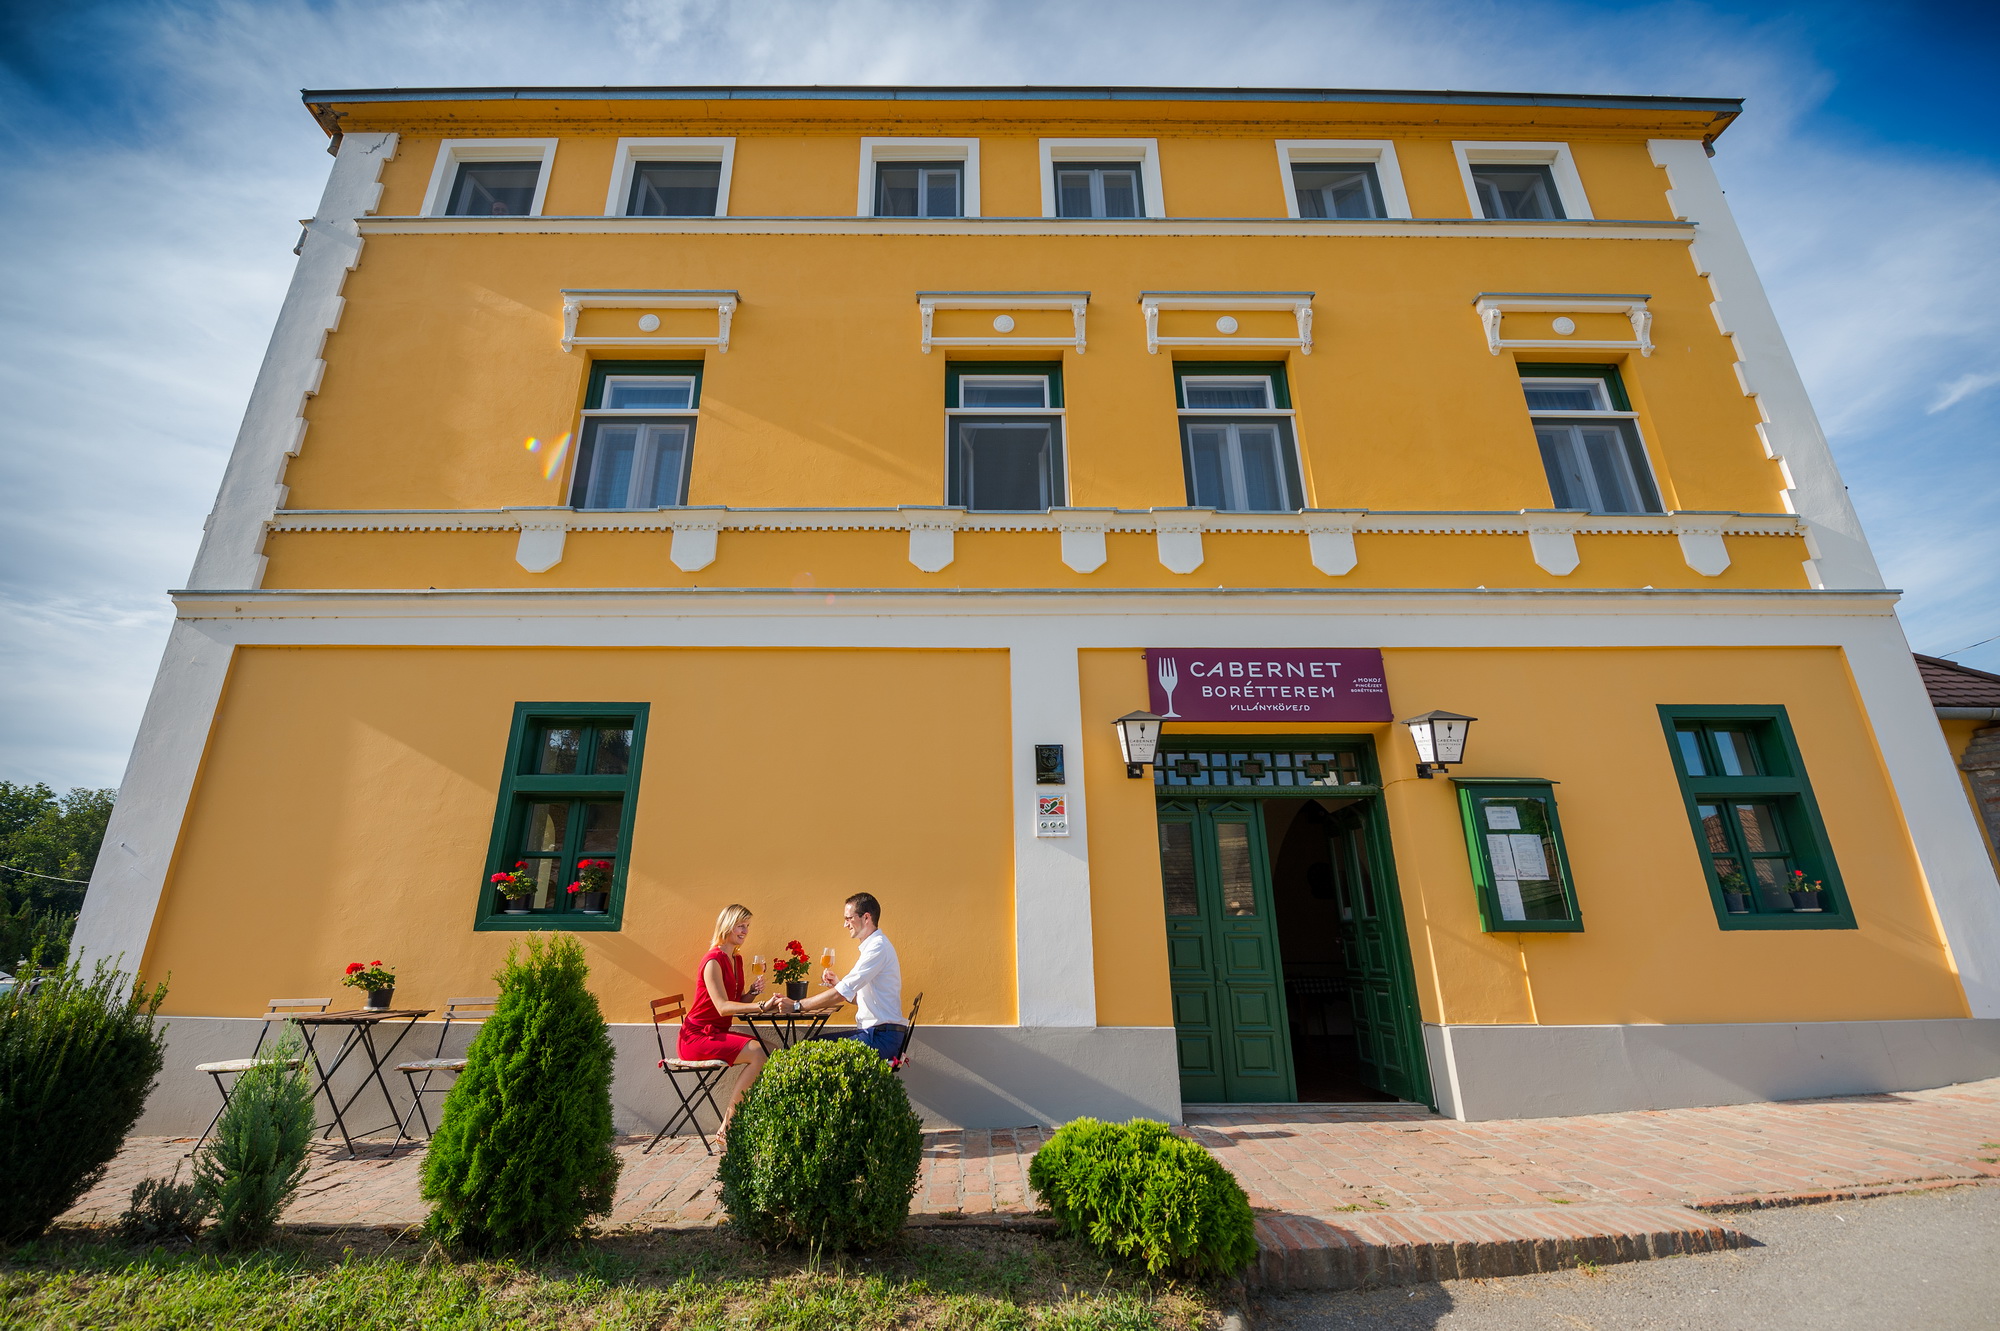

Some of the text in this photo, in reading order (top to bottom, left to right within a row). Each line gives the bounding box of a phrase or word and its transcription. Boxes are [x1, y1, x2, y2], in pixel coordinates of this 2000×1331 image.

[1190, 661, 1342, 678] CABERNET
[1202, 680, 1335, 698] BORÉTTEREM
[1230, 701, 1310, 712] VILLÁNYKÖVESD
